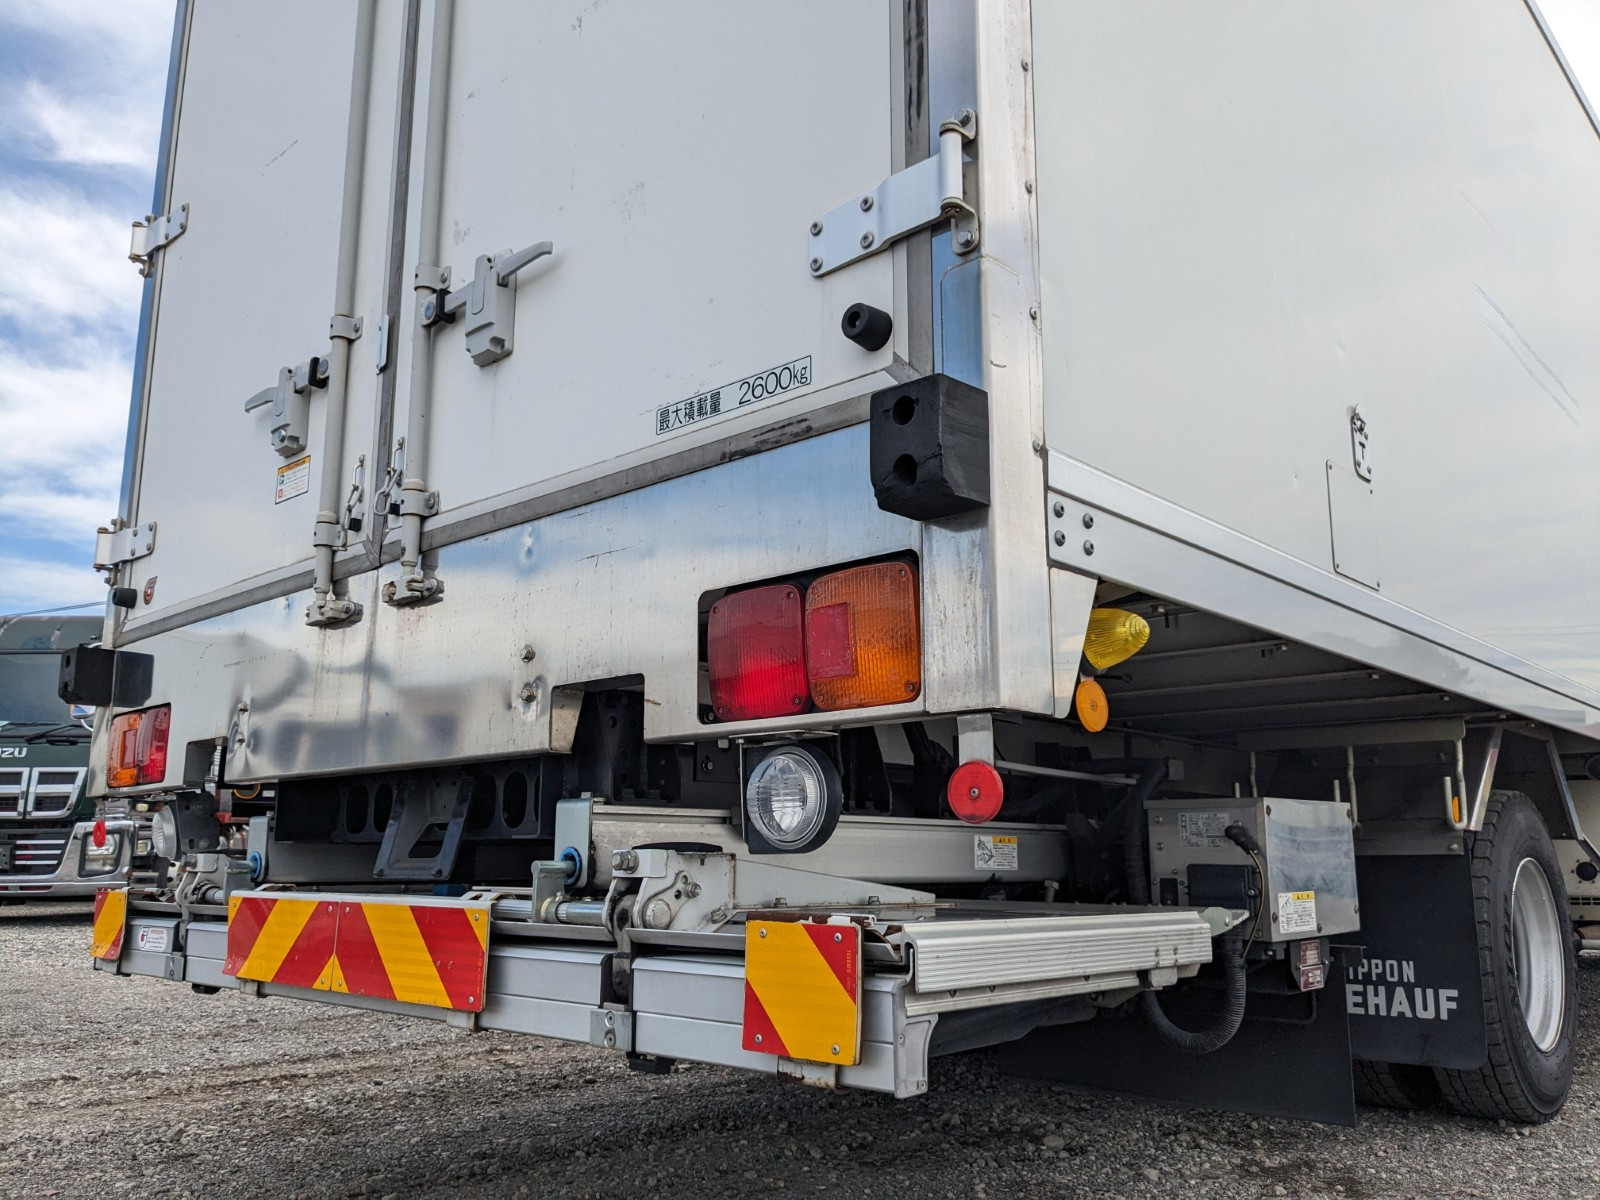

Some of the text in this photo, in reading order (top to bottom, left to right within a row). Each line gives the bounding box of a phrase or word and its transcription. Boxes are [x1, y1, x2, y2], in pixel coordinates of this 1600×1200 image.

[658, 363, 808, 432] 最大積載量 2600kg
[0, 747, 28, 758] ZU
[1345, 983, 1459, 1020] EHAUF
